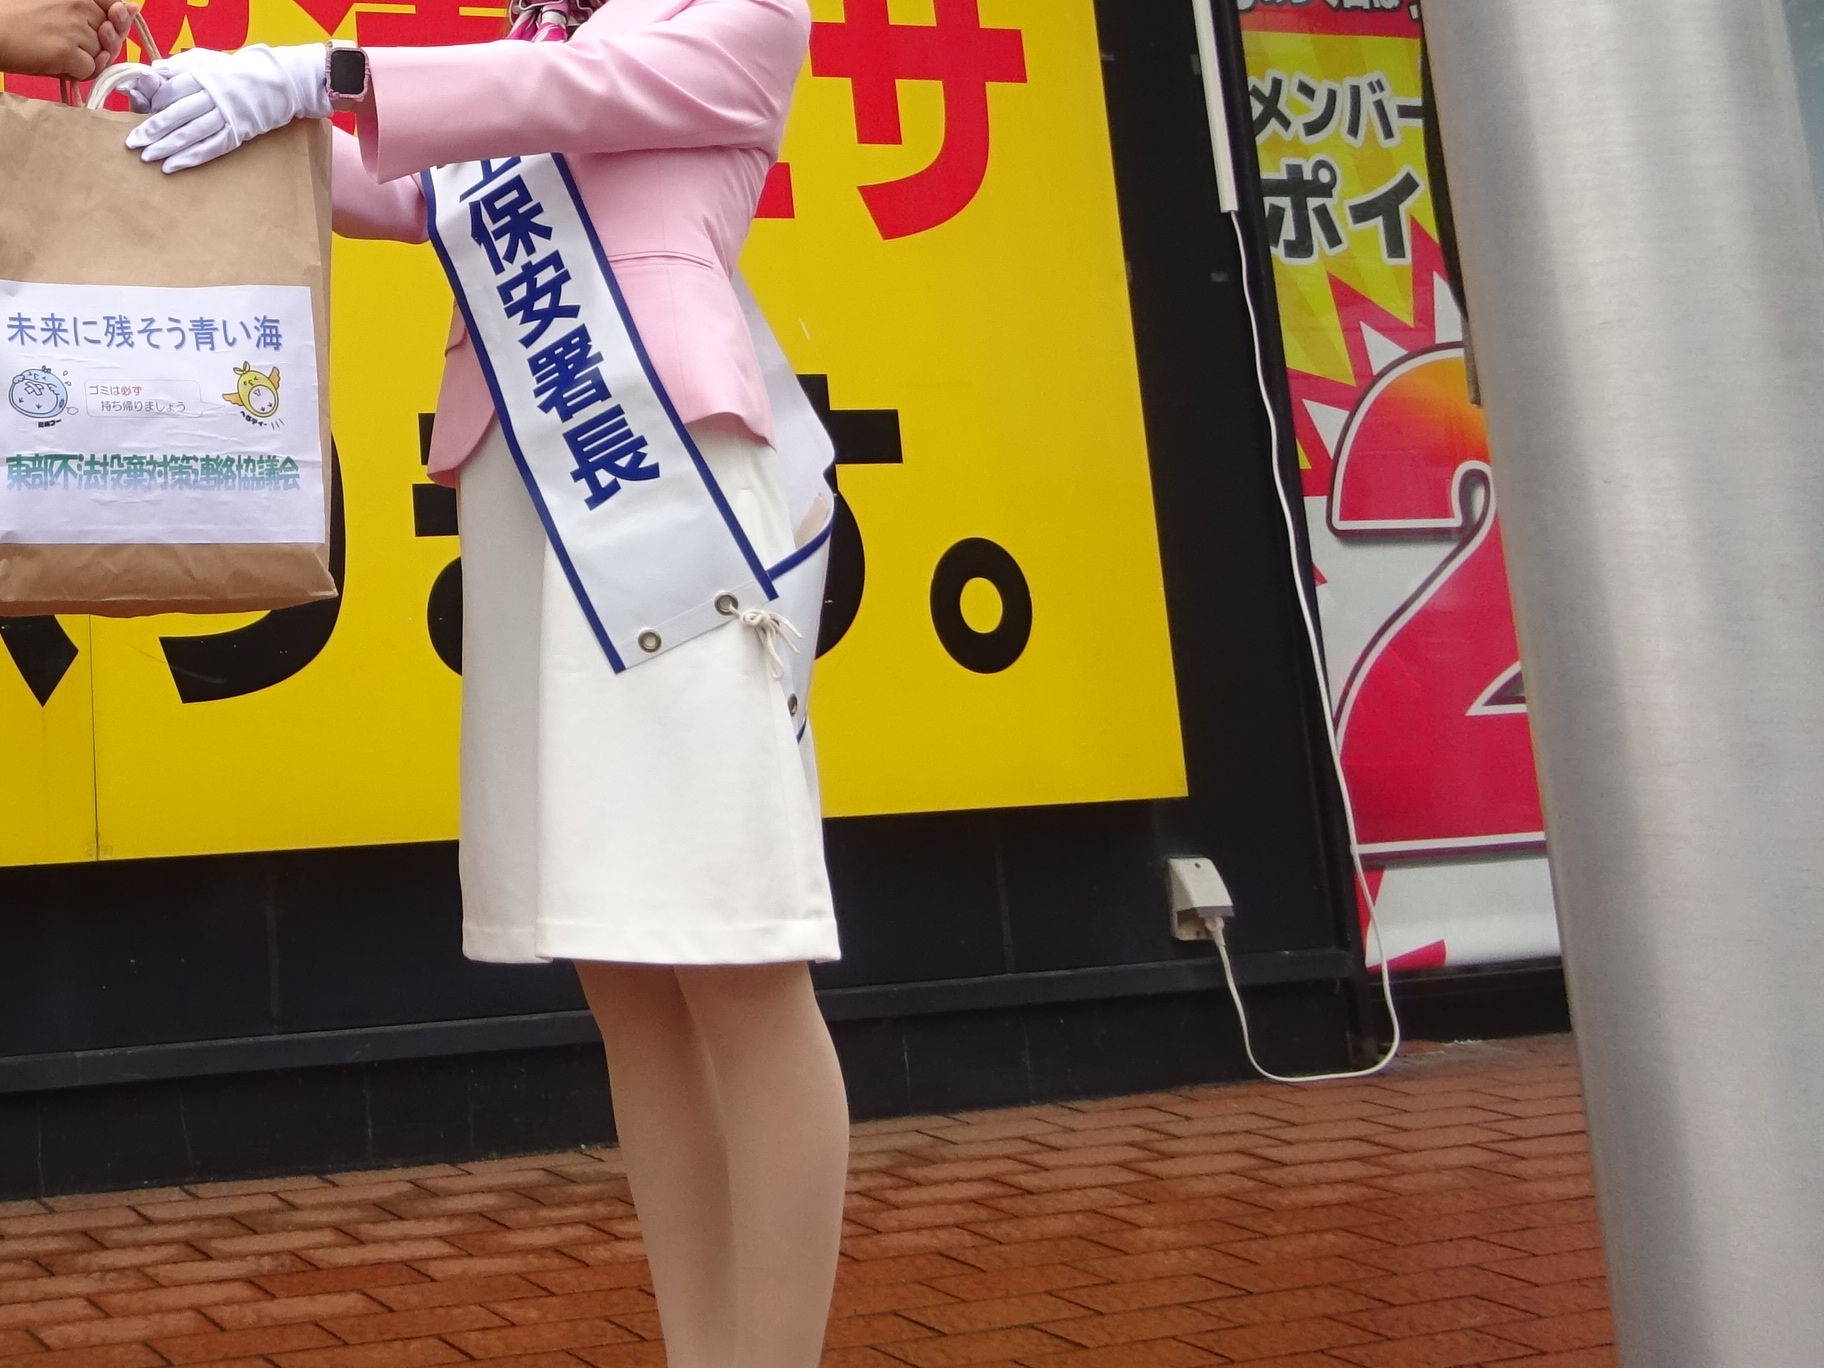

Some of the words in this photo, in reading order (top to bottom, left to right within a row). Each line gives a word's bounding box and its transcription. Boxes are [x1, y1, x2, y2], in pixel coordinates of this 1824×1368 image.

[6, 311, 284, 351] 未来に残そう青い海
[459, 155, 661, 511] 保安署長
[88, 385, 143, 397] ゴミは必ず
[100, 400, 187, 413] 持ち帰りましょう
[5, 453, 301, 492] 東部不法投棄対策連絡協議会
